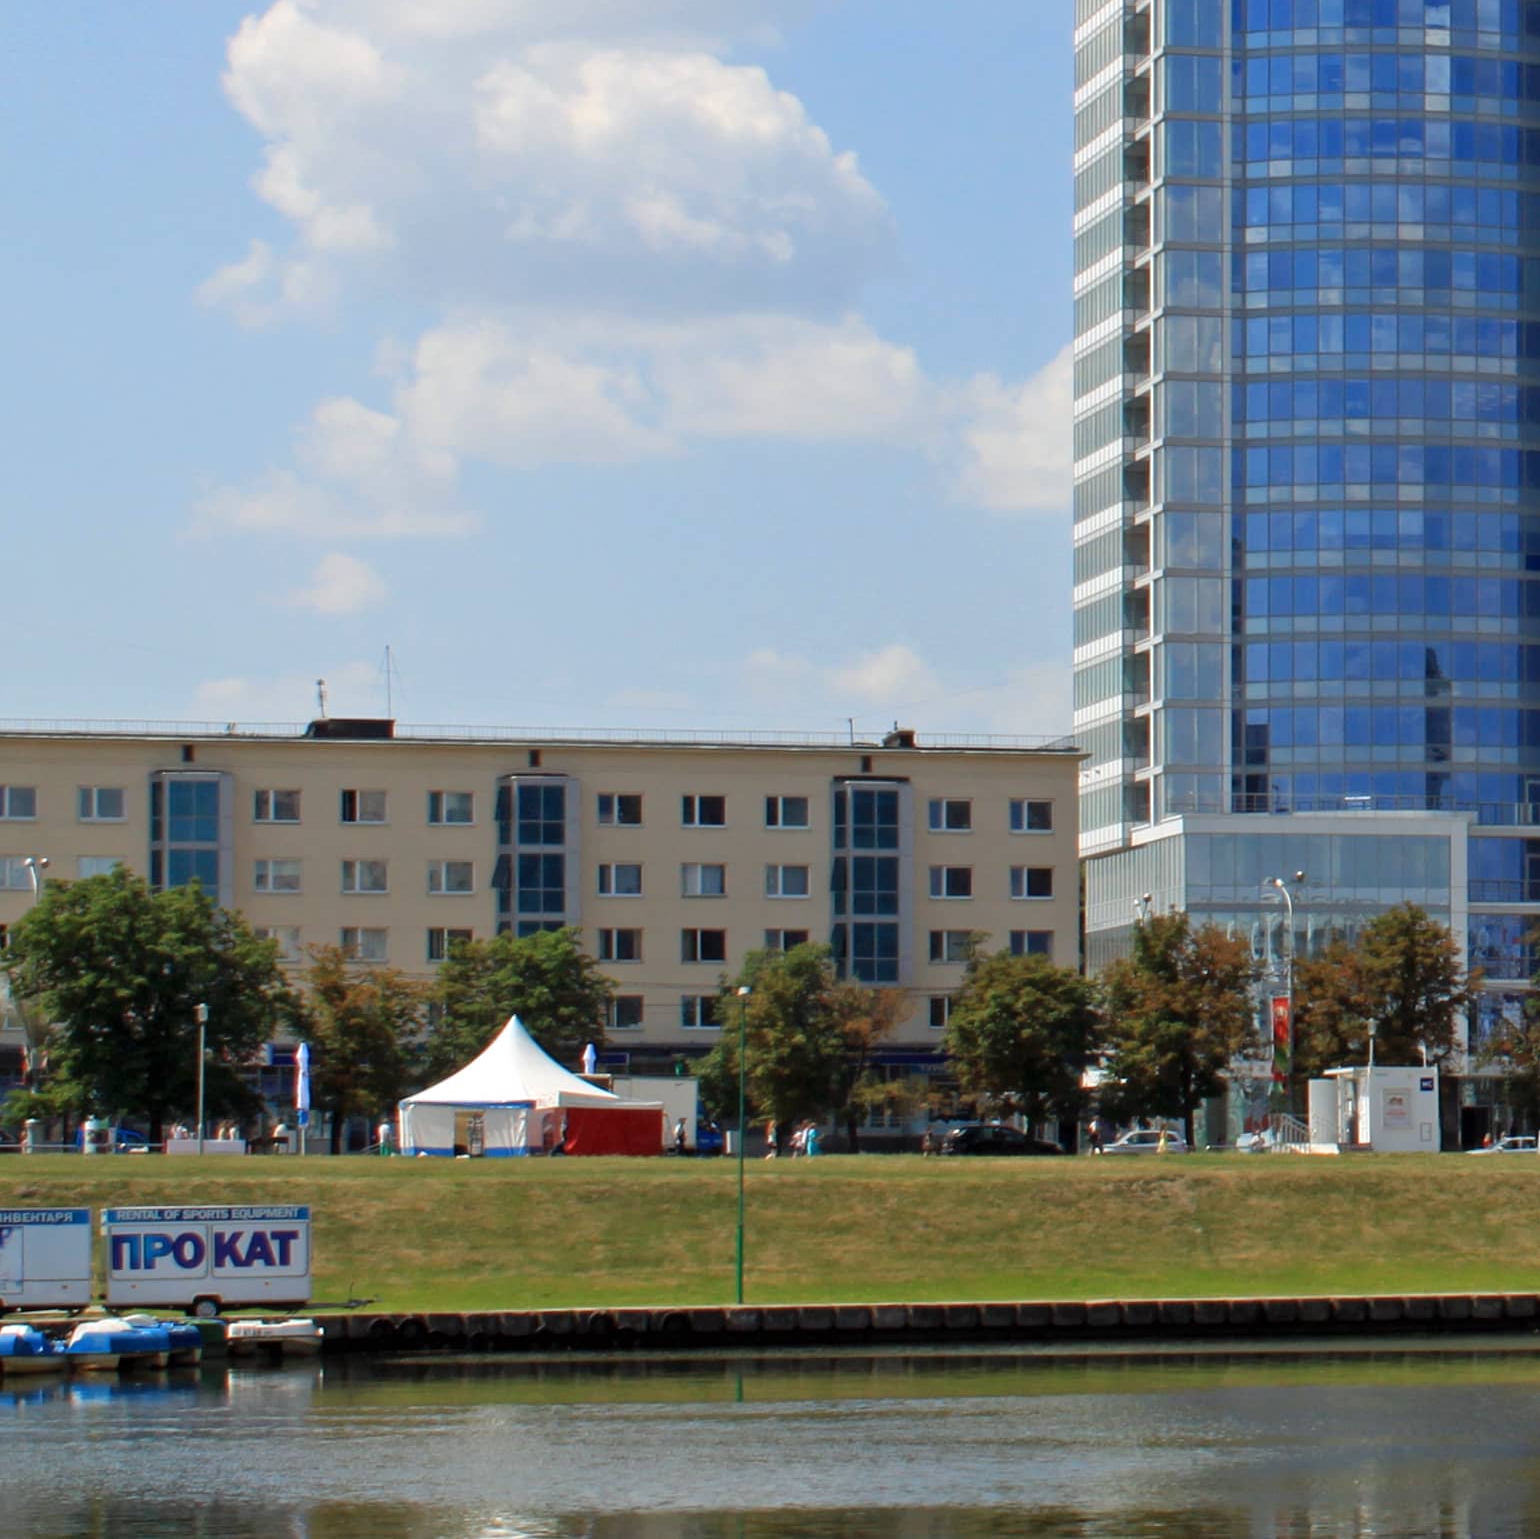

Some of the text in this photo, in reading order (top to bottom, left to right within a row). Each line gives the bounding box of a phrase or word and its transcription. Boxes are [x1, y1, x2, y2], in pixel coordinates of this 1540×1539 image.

[117, 1207, 299, 1220] RENTAL OF SPORTS EQUIPMENT
